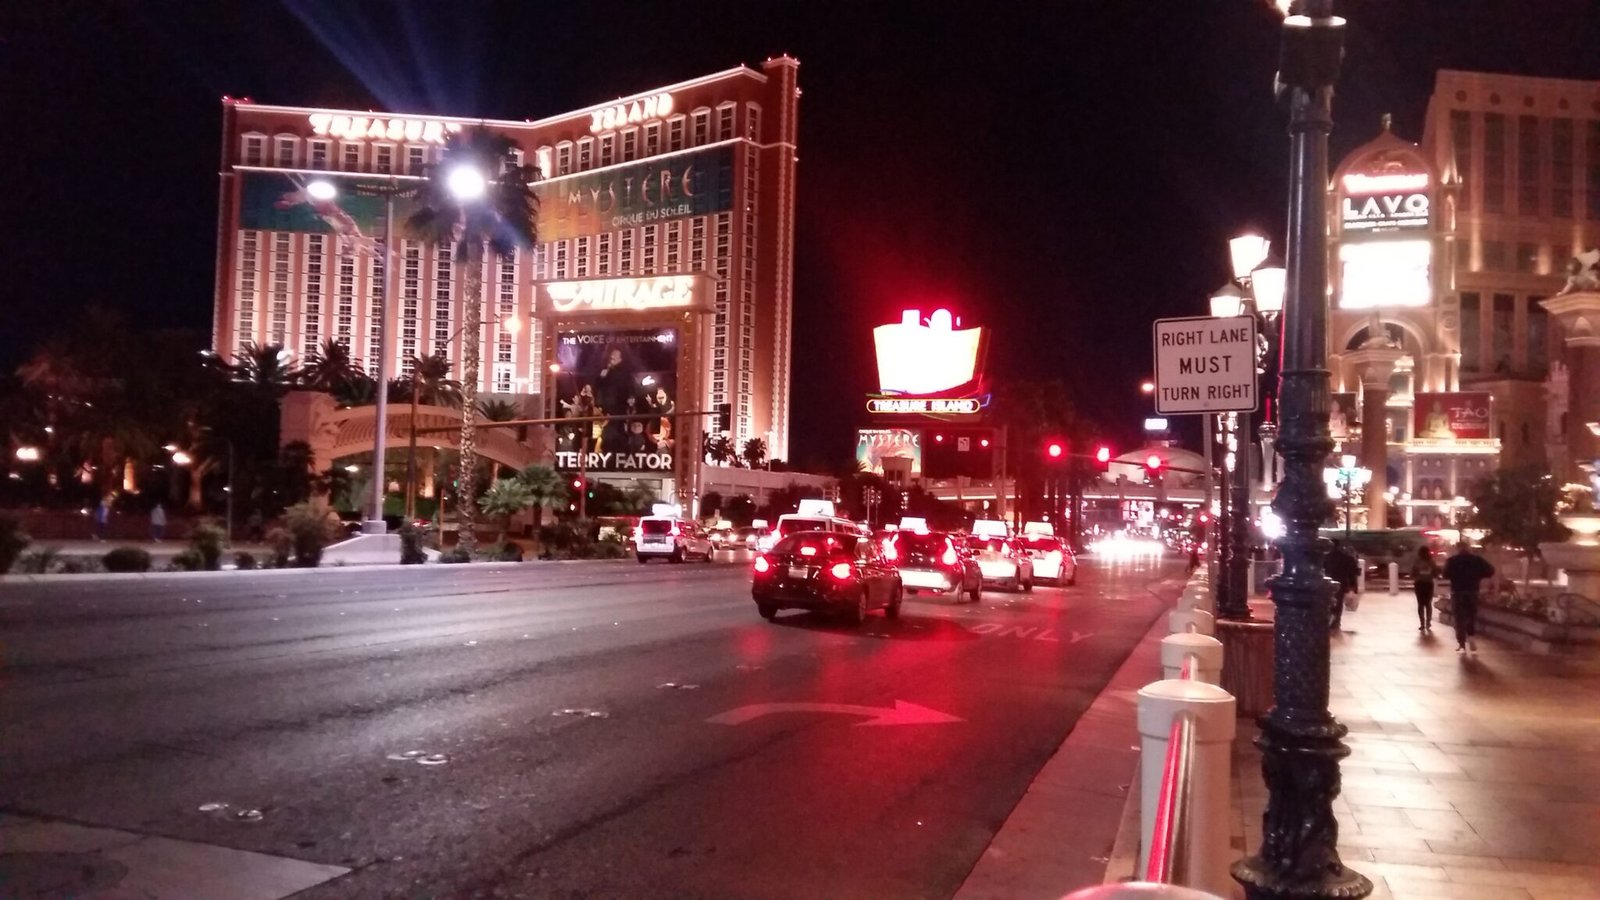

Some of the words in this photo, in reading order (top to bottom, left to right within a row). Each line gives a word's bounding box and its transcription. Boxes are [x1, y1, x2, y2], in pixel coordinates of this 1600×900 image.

[590, 92, 673, 133] ISLAND
[1343, 194, 1429, 219] LAVO
[547, 276, 694, 311] MIRAGE
[563, 337, 576, 345] THE
[577, 335, 605, 344] VOICE
[1162, 330, 1204, 346] RIGHT
[1210, 328, 1248, 343] LANE
[1179, 355, 1232, 374] MUST
[1162, 386, 1200, 401] TURN
[1207, 384, 1251, 399] RIGHT
[1450, 407, 1489, 418] TAO
[555, 452, 613, 470] TERRY
[615, 451, 672, 470] FATOR
[971, 622, 1095, 643] ONLY
